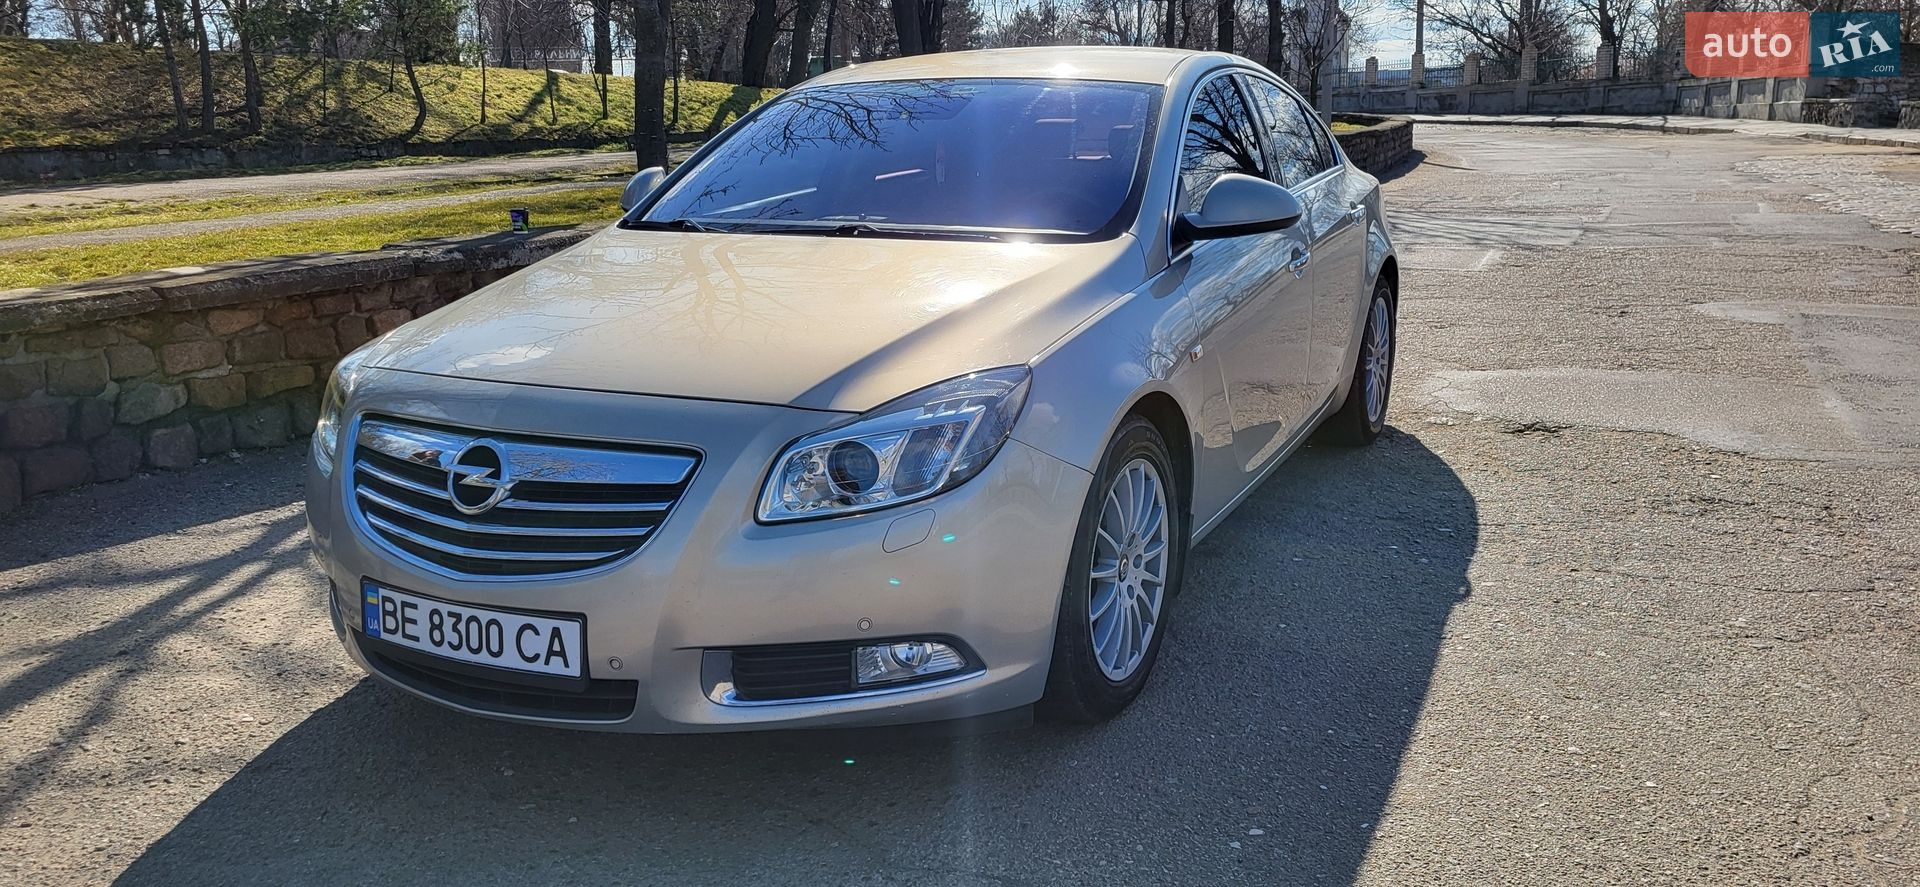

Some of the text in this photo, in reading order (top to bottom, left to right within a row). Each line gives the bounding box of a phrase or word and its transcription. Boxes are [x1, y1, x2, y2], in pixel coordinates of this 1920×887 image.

[367, 617, 380, 631] UA
[381, 595, 570, 668] BE 8300 CA
